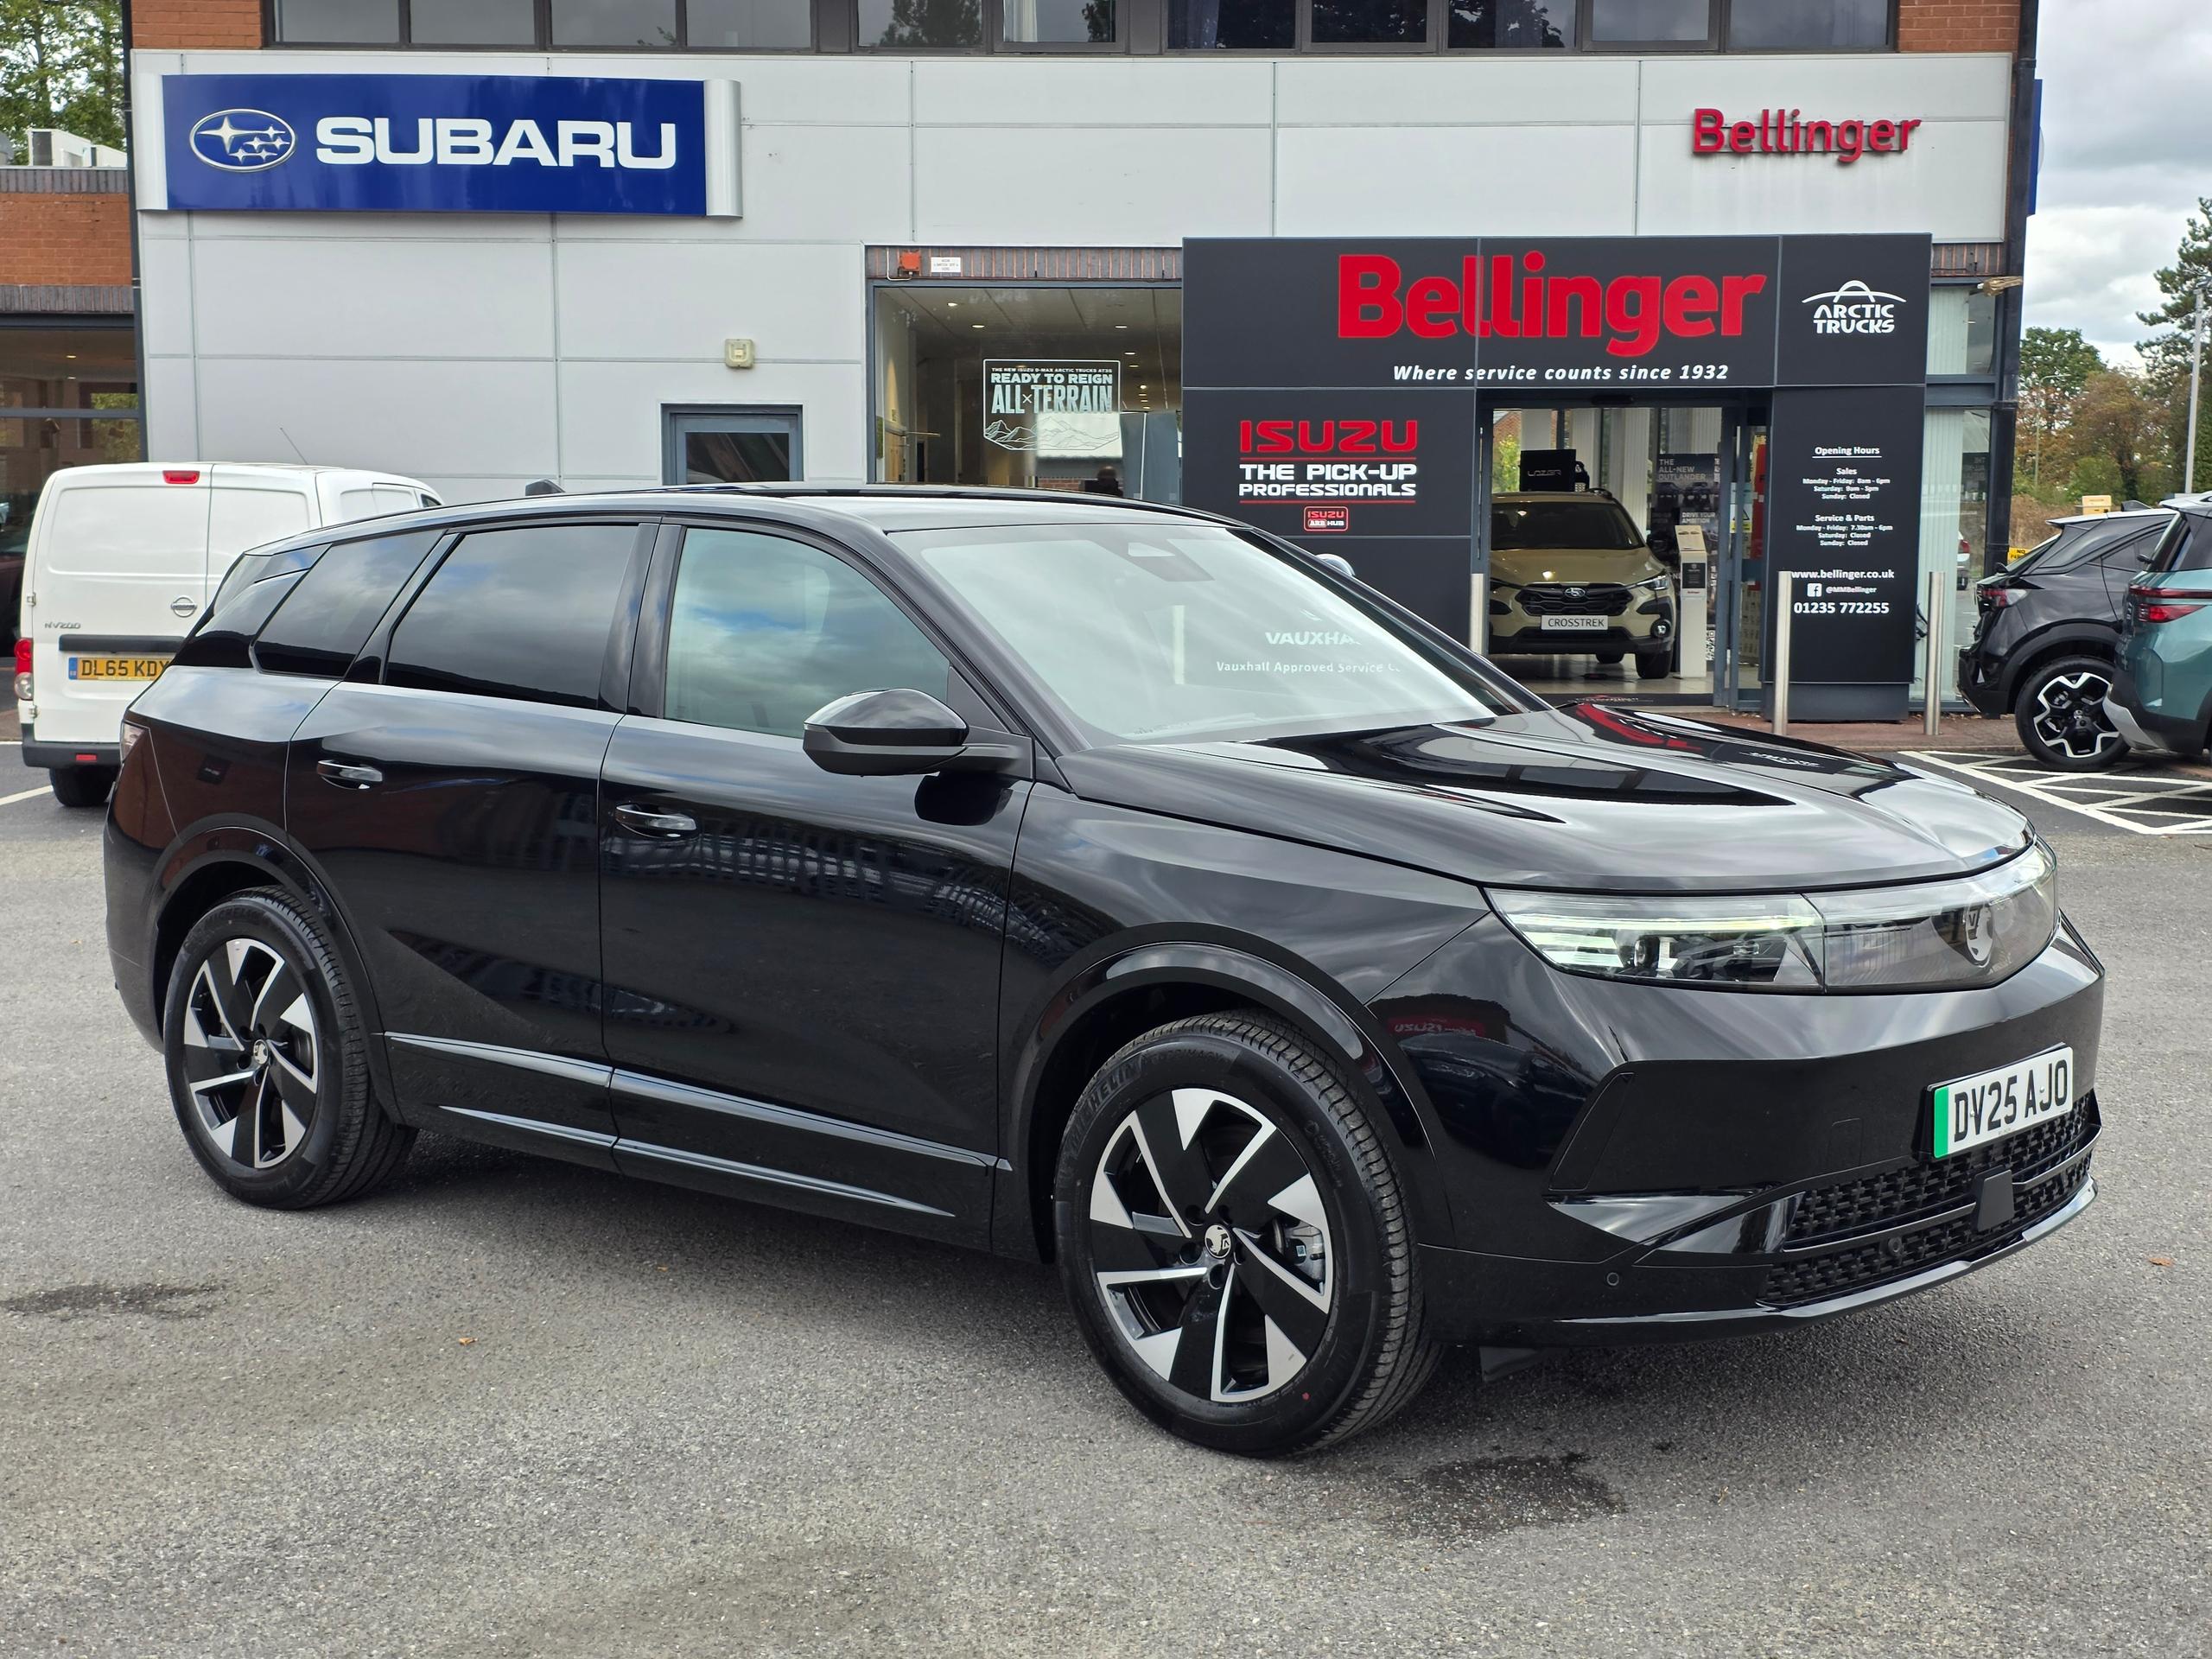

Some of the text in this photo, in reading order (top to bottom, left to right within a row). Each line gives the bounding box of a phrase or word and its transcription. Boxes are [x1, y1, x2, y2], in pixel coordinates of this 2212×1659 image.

[1693, 108, 1922, 162] Bellinger
[316, 117, 676, 169] SUBARU
[1338, 250, 1767, 357] Bellinger
[1813, 303, 1895, 318] ARCTIC
[1813, 319, 1895, 334] TRUCKS
[991, 373, 1113, 385] READY TO REIGN
[1393, 365, 1729, 381] Where service counts since 1932
[1239, 420, 1418, 453] ISUZU
[1815, 447, 1853, 455] Opening
[1239, 464, 1417, 480] THE PICK-UP
[1238, 483, 1416, 497] PROFESSIONALS
[1791, 569, 1895, 580] www.bellinger.co.uk
[1794, 602, 1890, 613] 01235 772255
[1548, 619, 1605, 627] CROSSTREK
[1264, 631, 1362, 645] VAUXHA
[81, 659, 129, 677] DL65
[1217, 661, 1270, 672] Vauxhall
[1274, 661, 1333, 673] Approved
[1338, 663, 1383, 673] Service
[1954, 1059, 2069, 1142] DV25 AJO
